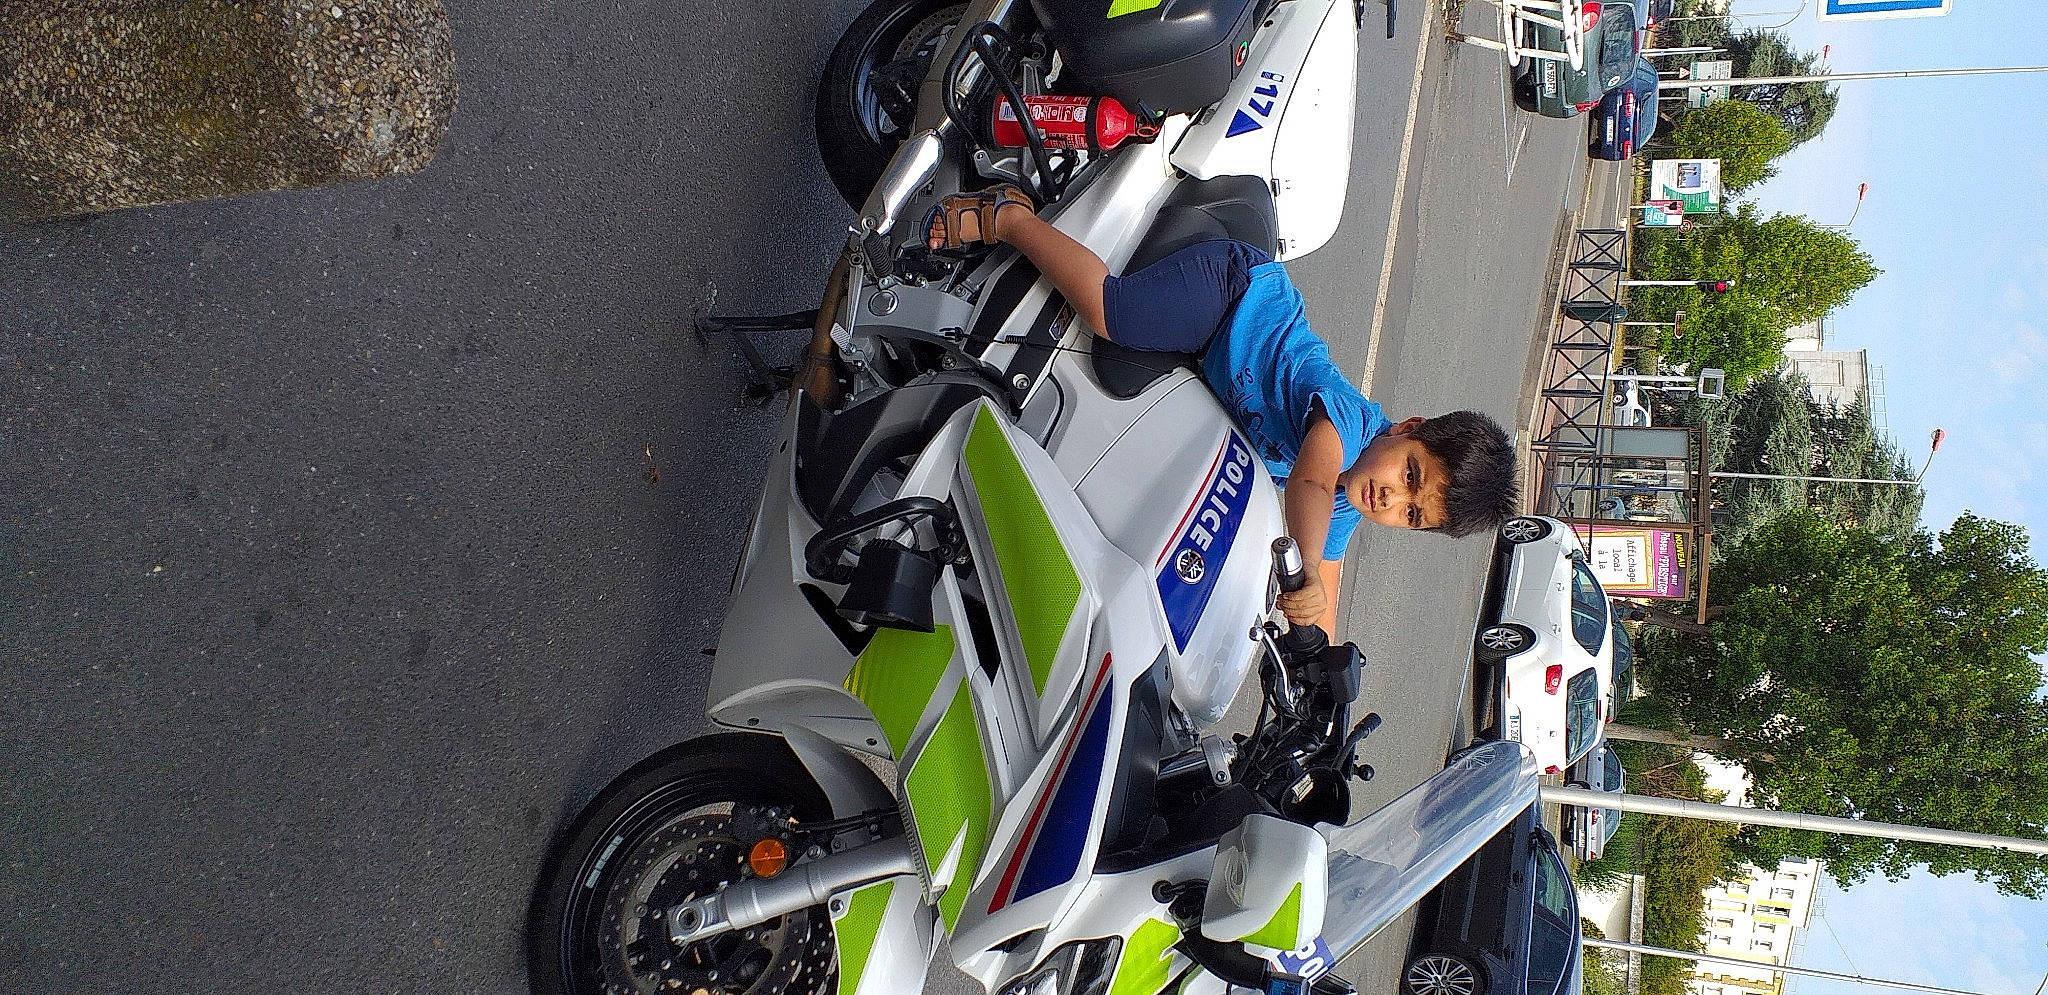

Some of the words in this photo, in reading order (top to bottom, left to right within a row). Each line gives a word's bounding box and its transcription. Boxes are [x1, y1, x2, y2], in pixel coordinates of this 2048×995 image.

[1189, 443, 1250, 552] POLICE
[1659, 532, 1671, 555] Réseau
[1674, 533, 1686, 568] NOUVEAU
[1598, 560, 1607, 570] la
[1612, 548, 1623, 572] local
[1626, 539, 1637, 583] Affichage
[1671, 574, 1679, 586] sur
